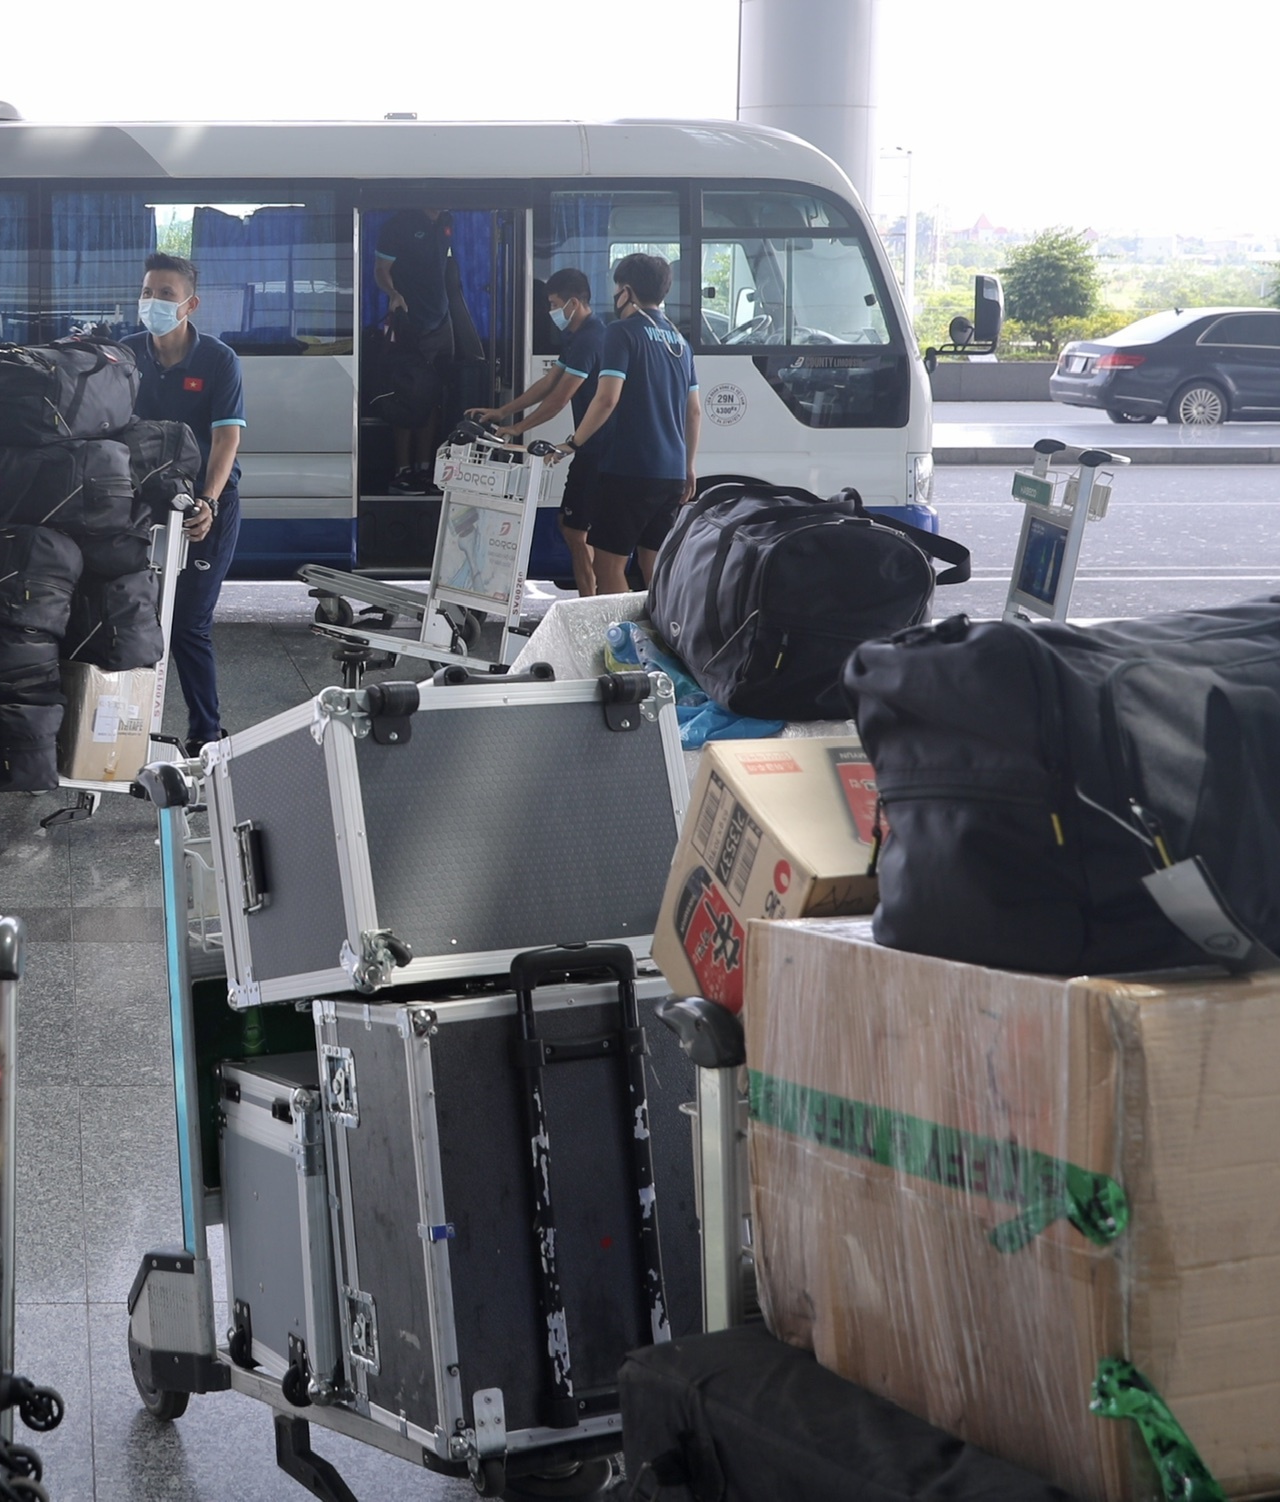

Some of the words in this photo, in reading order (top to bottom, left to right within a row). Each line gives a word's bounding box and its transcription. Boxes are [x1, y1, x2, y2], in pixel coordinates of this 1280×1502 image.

[456, 472, 496, 486] DORCO
[489, 538, 517, 551] DORCO
[840, 751, 868, 760] MYUN
